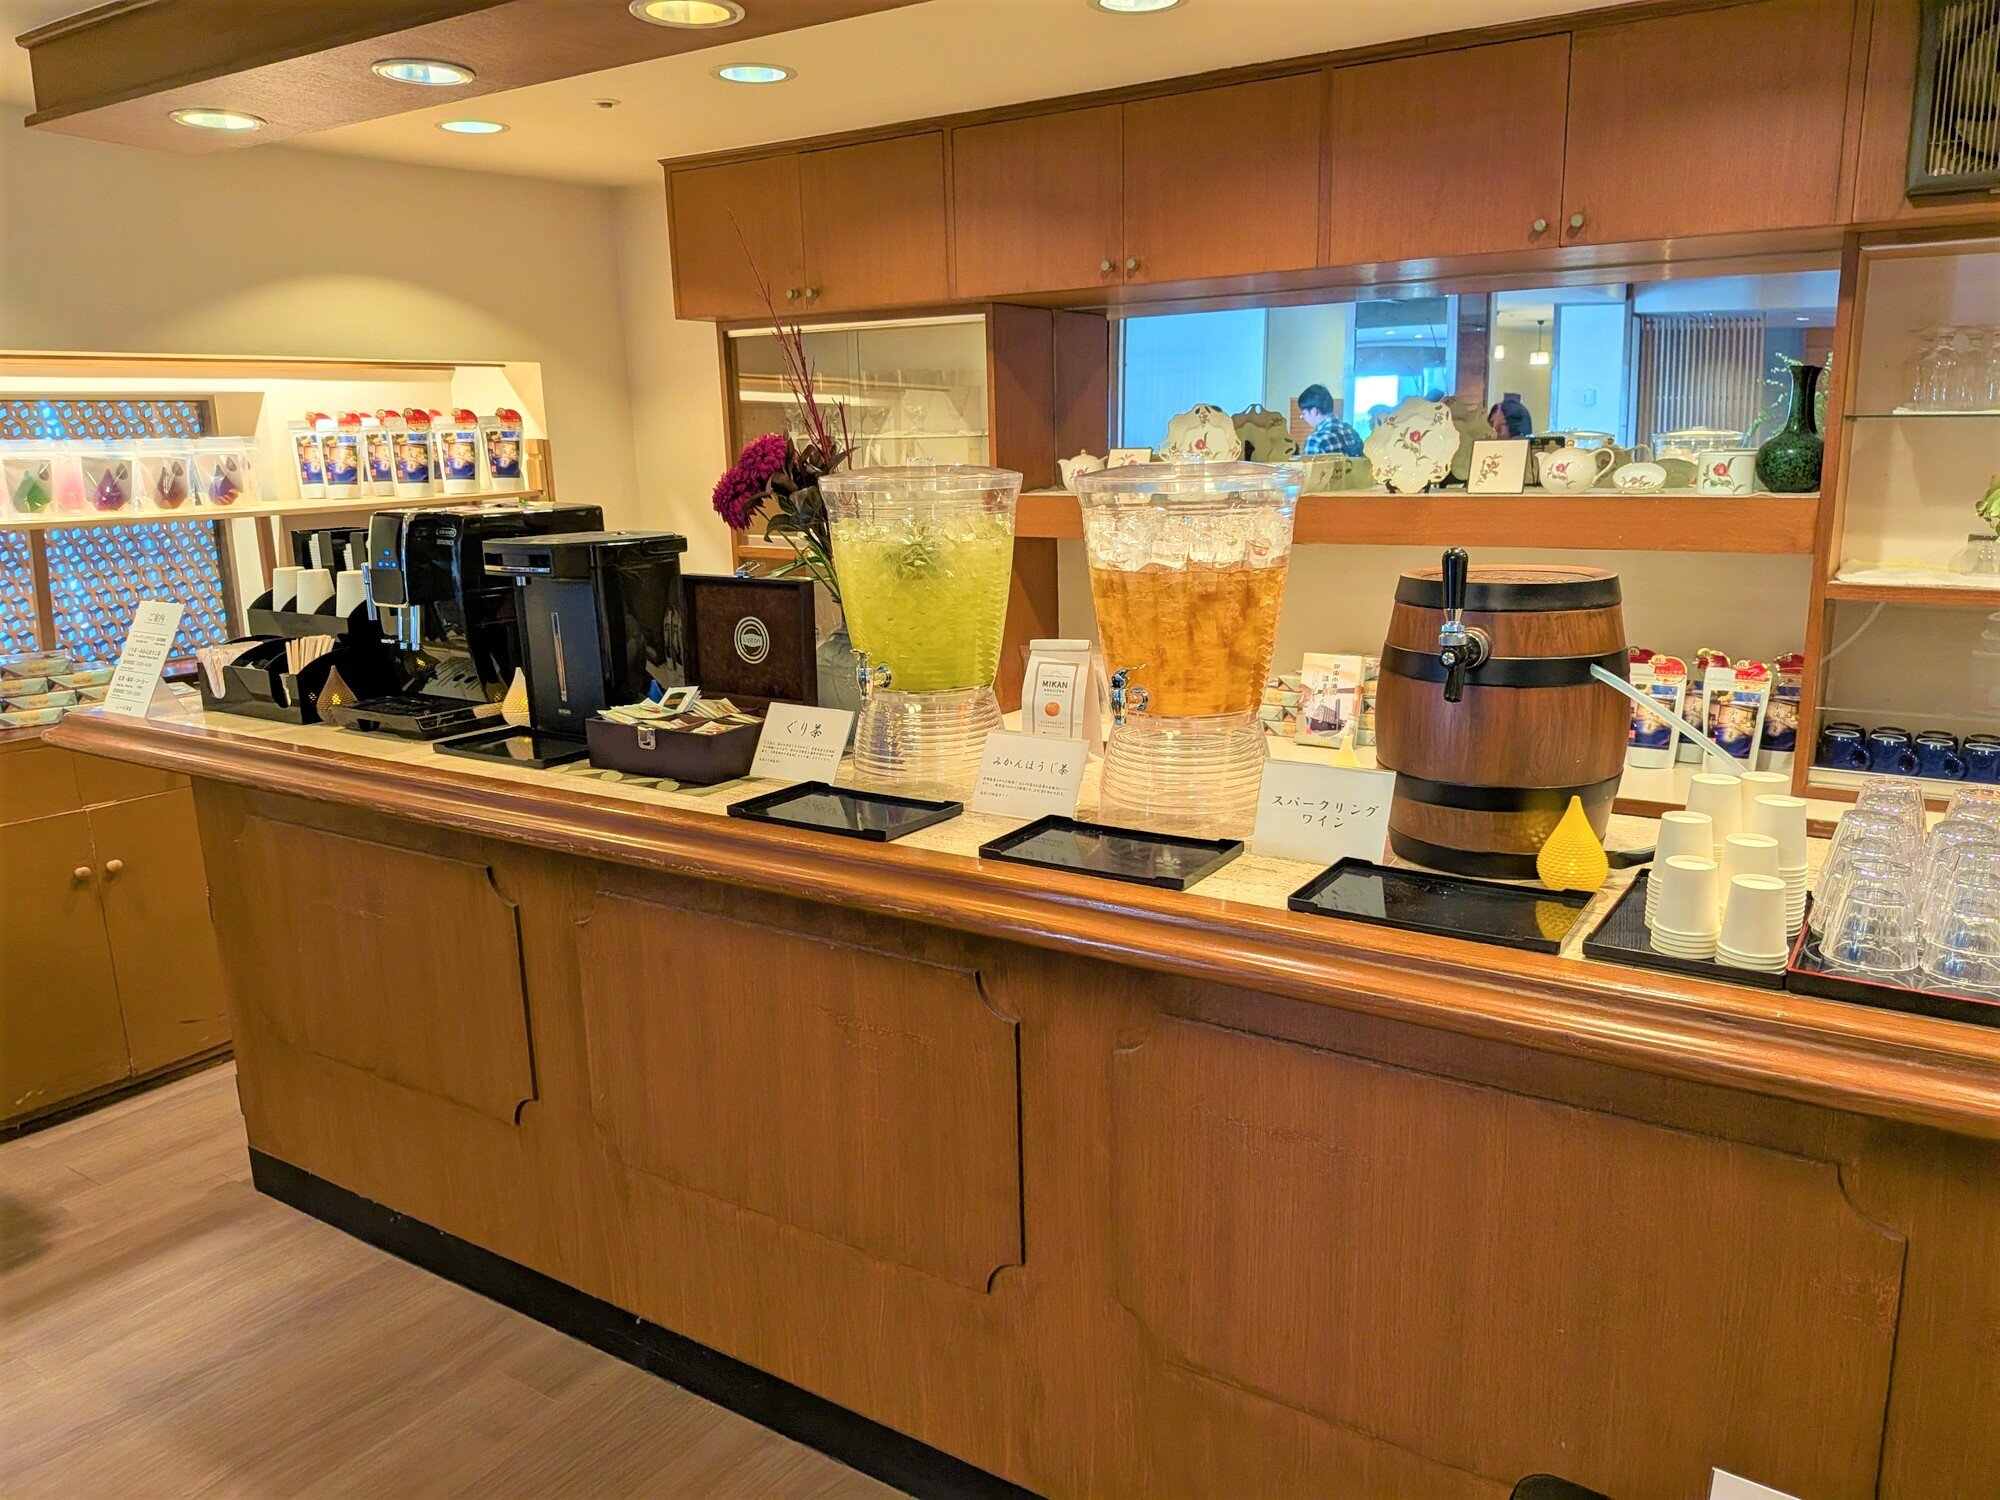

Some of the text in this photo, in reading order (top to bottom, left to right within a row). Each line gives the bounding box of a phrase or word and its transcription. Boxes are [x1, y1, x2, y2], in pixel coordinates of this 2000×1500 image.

[1042, 680, 1068, 688] MIKAN
[786, 720, 822, 738] ぐり茶
[993, 757, 1069, 776] みかんほうじ茶
[1272, 795, 1380, 818] スパークリング
[1302, 813, 1344, 828] ワイン
